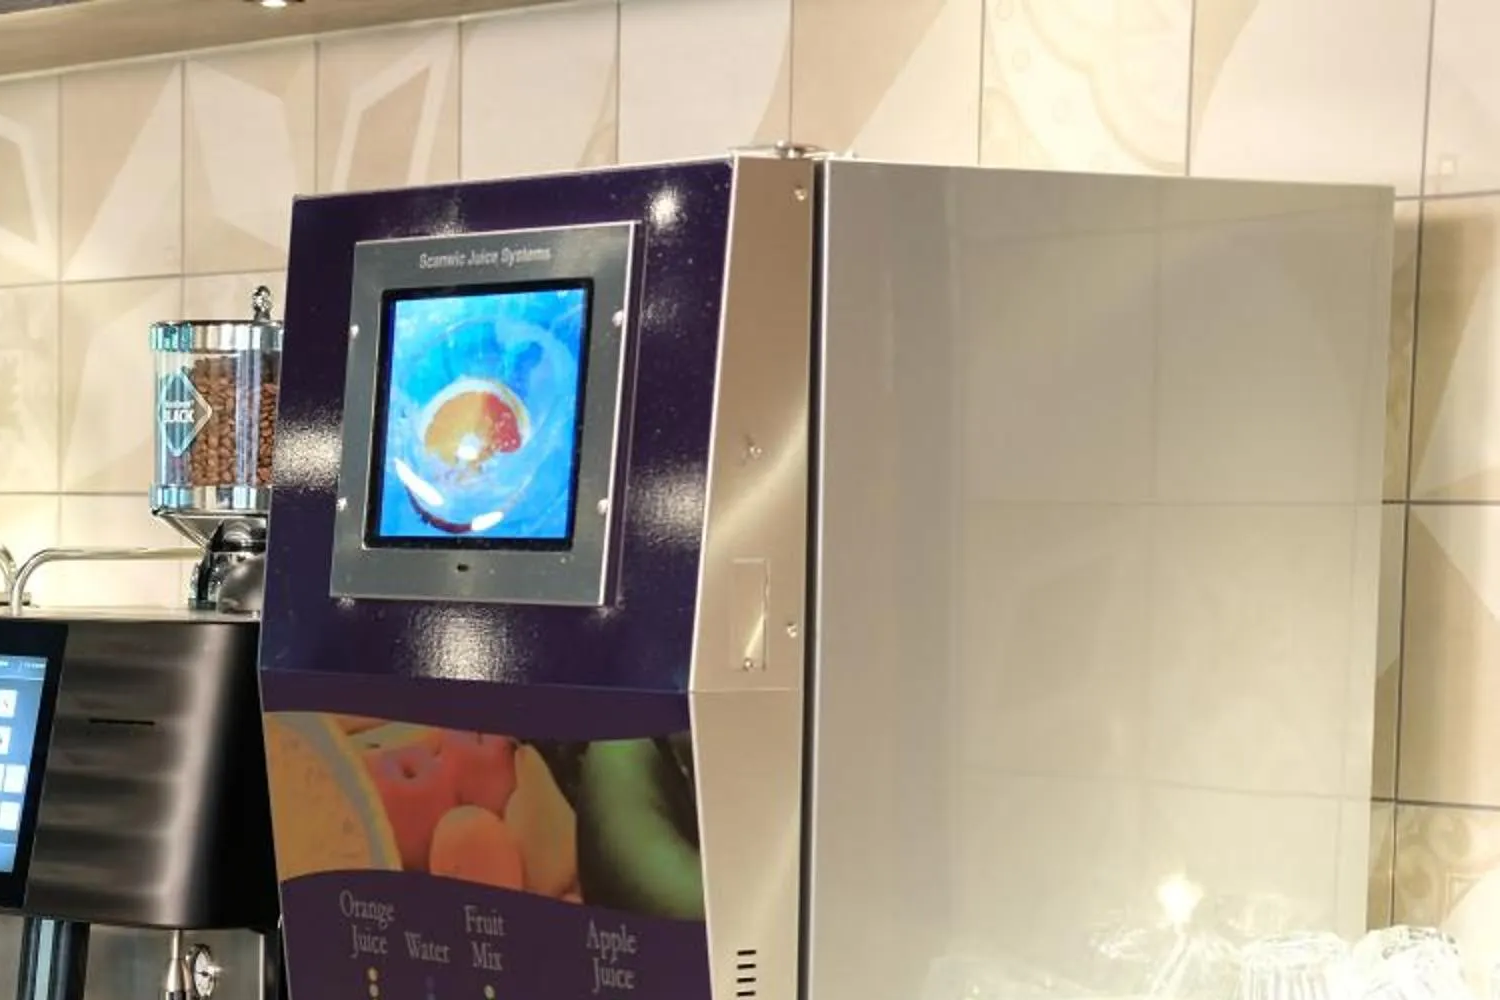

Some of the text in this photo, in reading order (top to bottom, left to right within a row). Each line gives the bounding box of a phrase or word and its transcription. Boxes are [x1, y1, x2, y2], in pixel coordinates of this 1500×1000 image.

[468, 249, 498, 266] Juice
[501, 246, 550, 268] Systems
[339, 889, 395, 930] Orange
[463, 904, 506, 936] Fruit
[350, 924, 389, 959] Juice
[404, 930, 450, 963] Water
[472, 940, 504, 971] Mix
[586, 919, 637, 965] Apple
[591, 956, 635, 995] Juice
